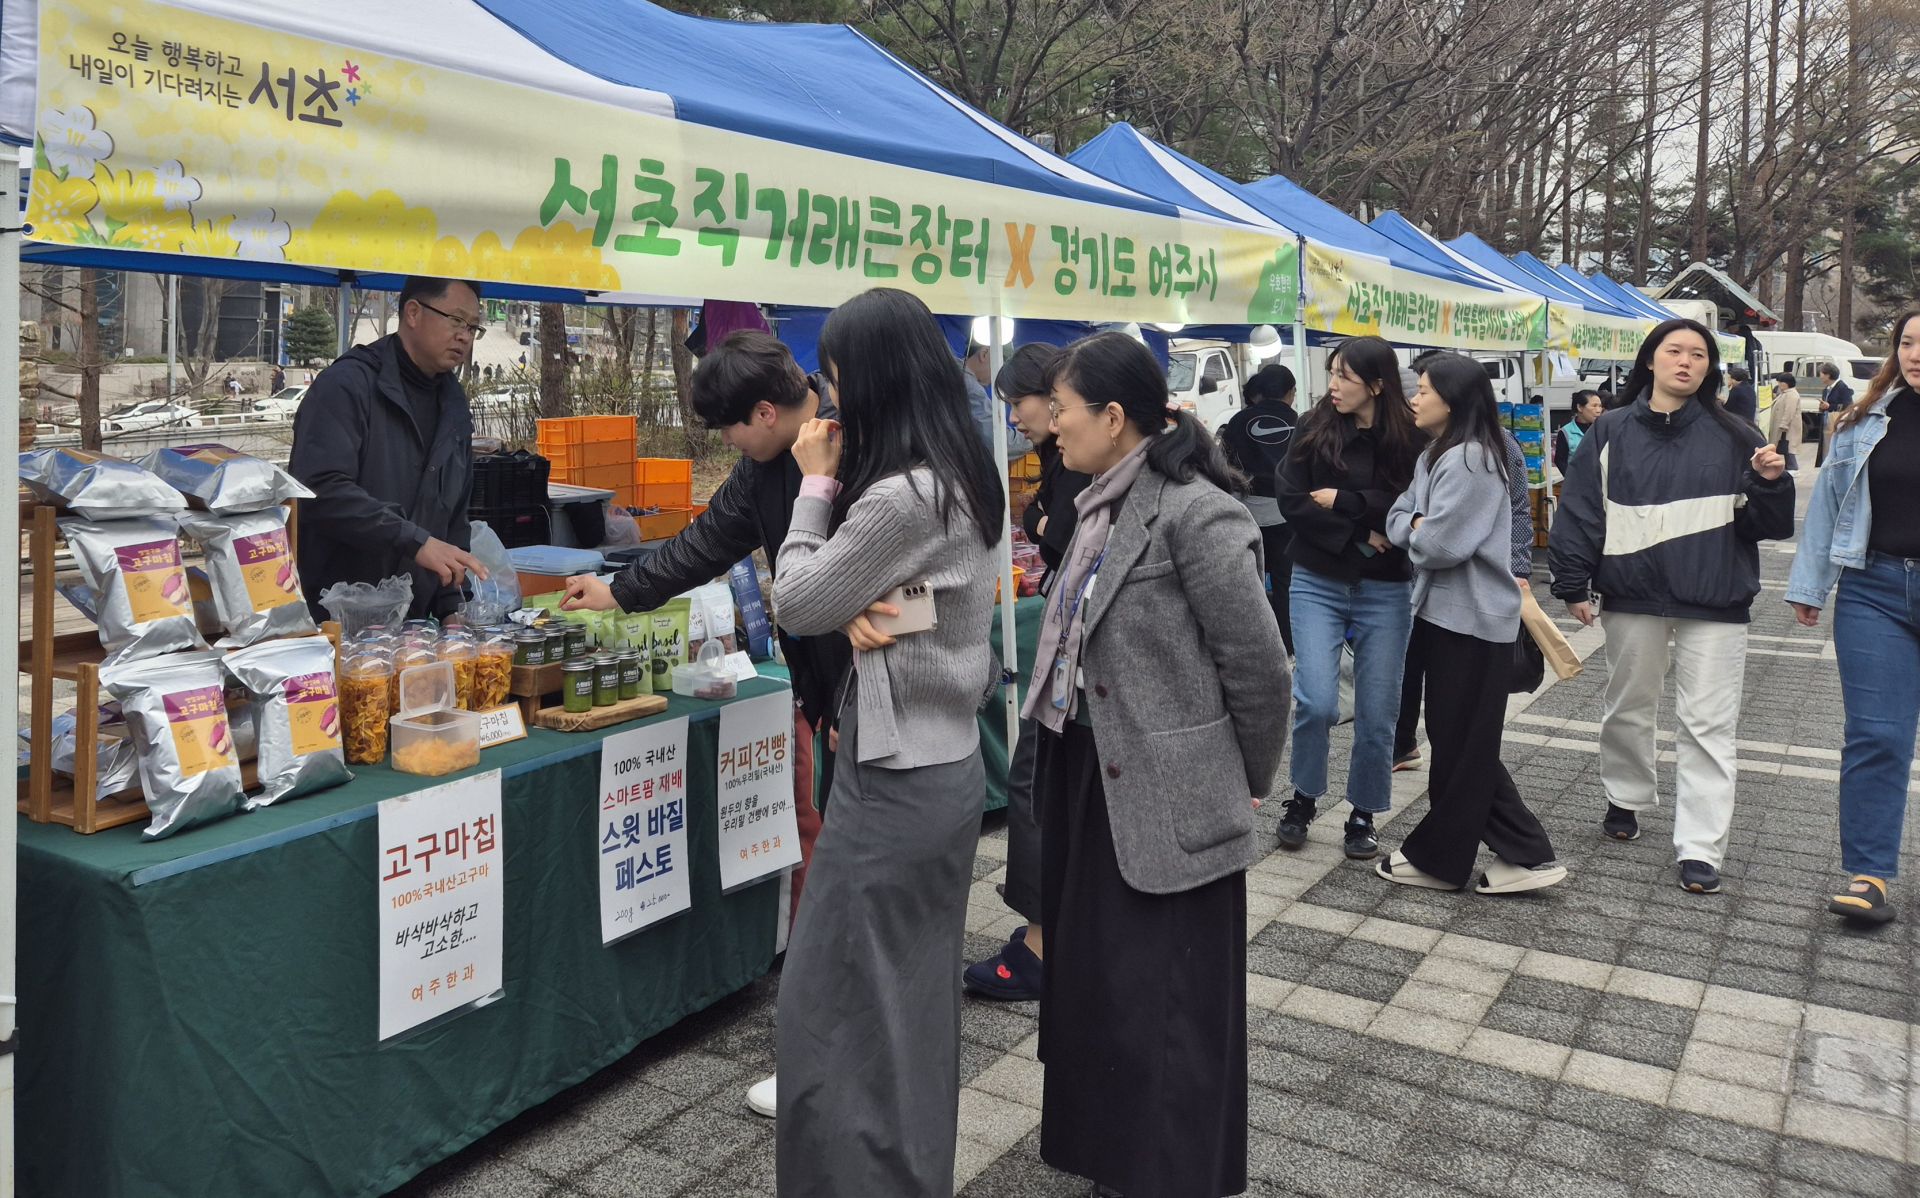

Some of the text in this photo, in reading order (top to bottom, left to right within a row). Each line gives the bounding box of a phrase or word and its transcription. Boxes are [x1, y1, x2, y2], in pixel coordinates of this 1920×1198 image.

[107, 32, 244, 77] 오늘 행복하고
[69, 54, 242, 109] 내일이 기다려지는
[248, 61, 343, 127] 서초
[1003, 221, 1036, 288] X
[1050, 224, 1136, 298] 경기도
[1147, 233, 1218, 302] 여주시
[1441, 300, 1451, 334] X
[248, 541, 285, 560] 고구마칩
[652, 628, 680, 650] basil
[179, 699, 218, 717] 고구마칩
[480, 711, 509, 730] 구마칩
[614, 744, 676, 776] 100% 국내산
[720, 732, 787, 777] 커피건빵
[603, 769, 683, 811] 스마트팜 재배
[382, 813, 496, 882] 고구마칩
[602, 798, 684, 855] 스윗 바질
[391, 863, 489, 909] 100%국내산고구마
[615, 843, 673, 891] 페스토
[395, 902, 479, 947] 바삭바삭하고
